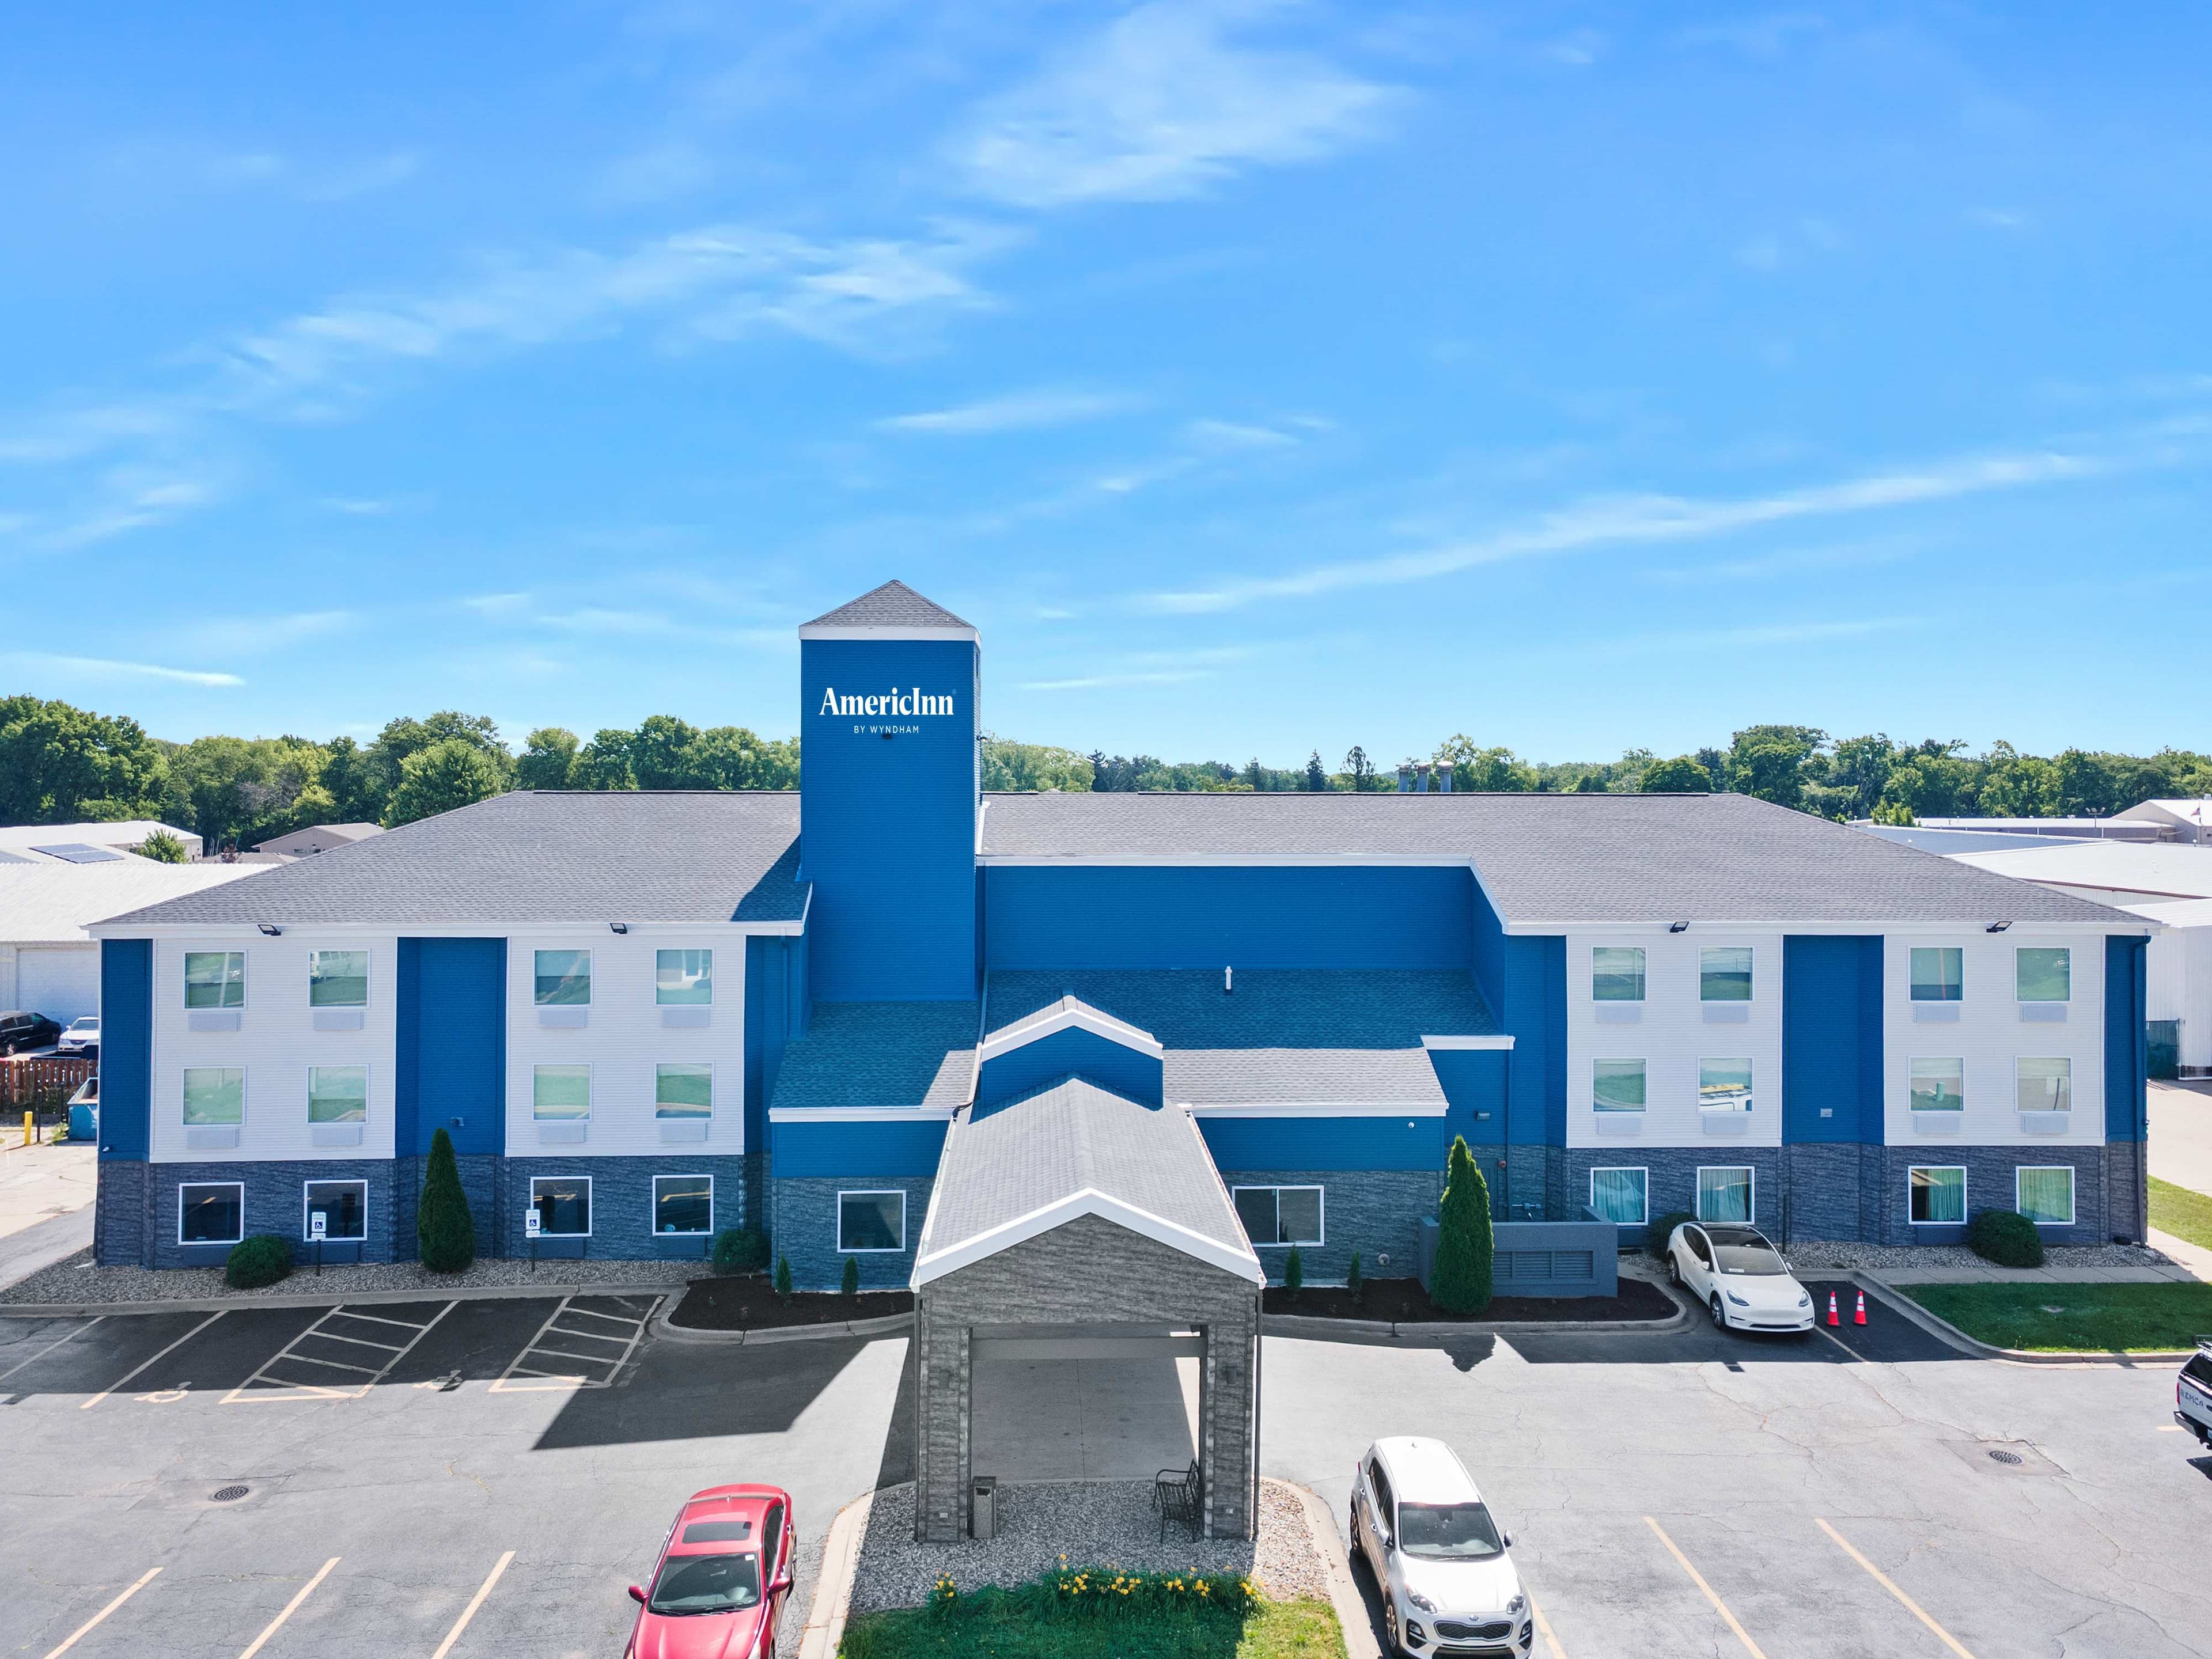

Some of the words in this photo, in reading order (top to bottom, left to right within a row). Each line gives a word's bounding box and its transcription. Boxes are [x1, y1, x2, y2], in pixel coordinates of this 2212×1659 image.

[819, 687, 954, 715] AmericInn
[854, 725, 865, 733] BY
[870, 725, 919, 733] WYNDHAM
